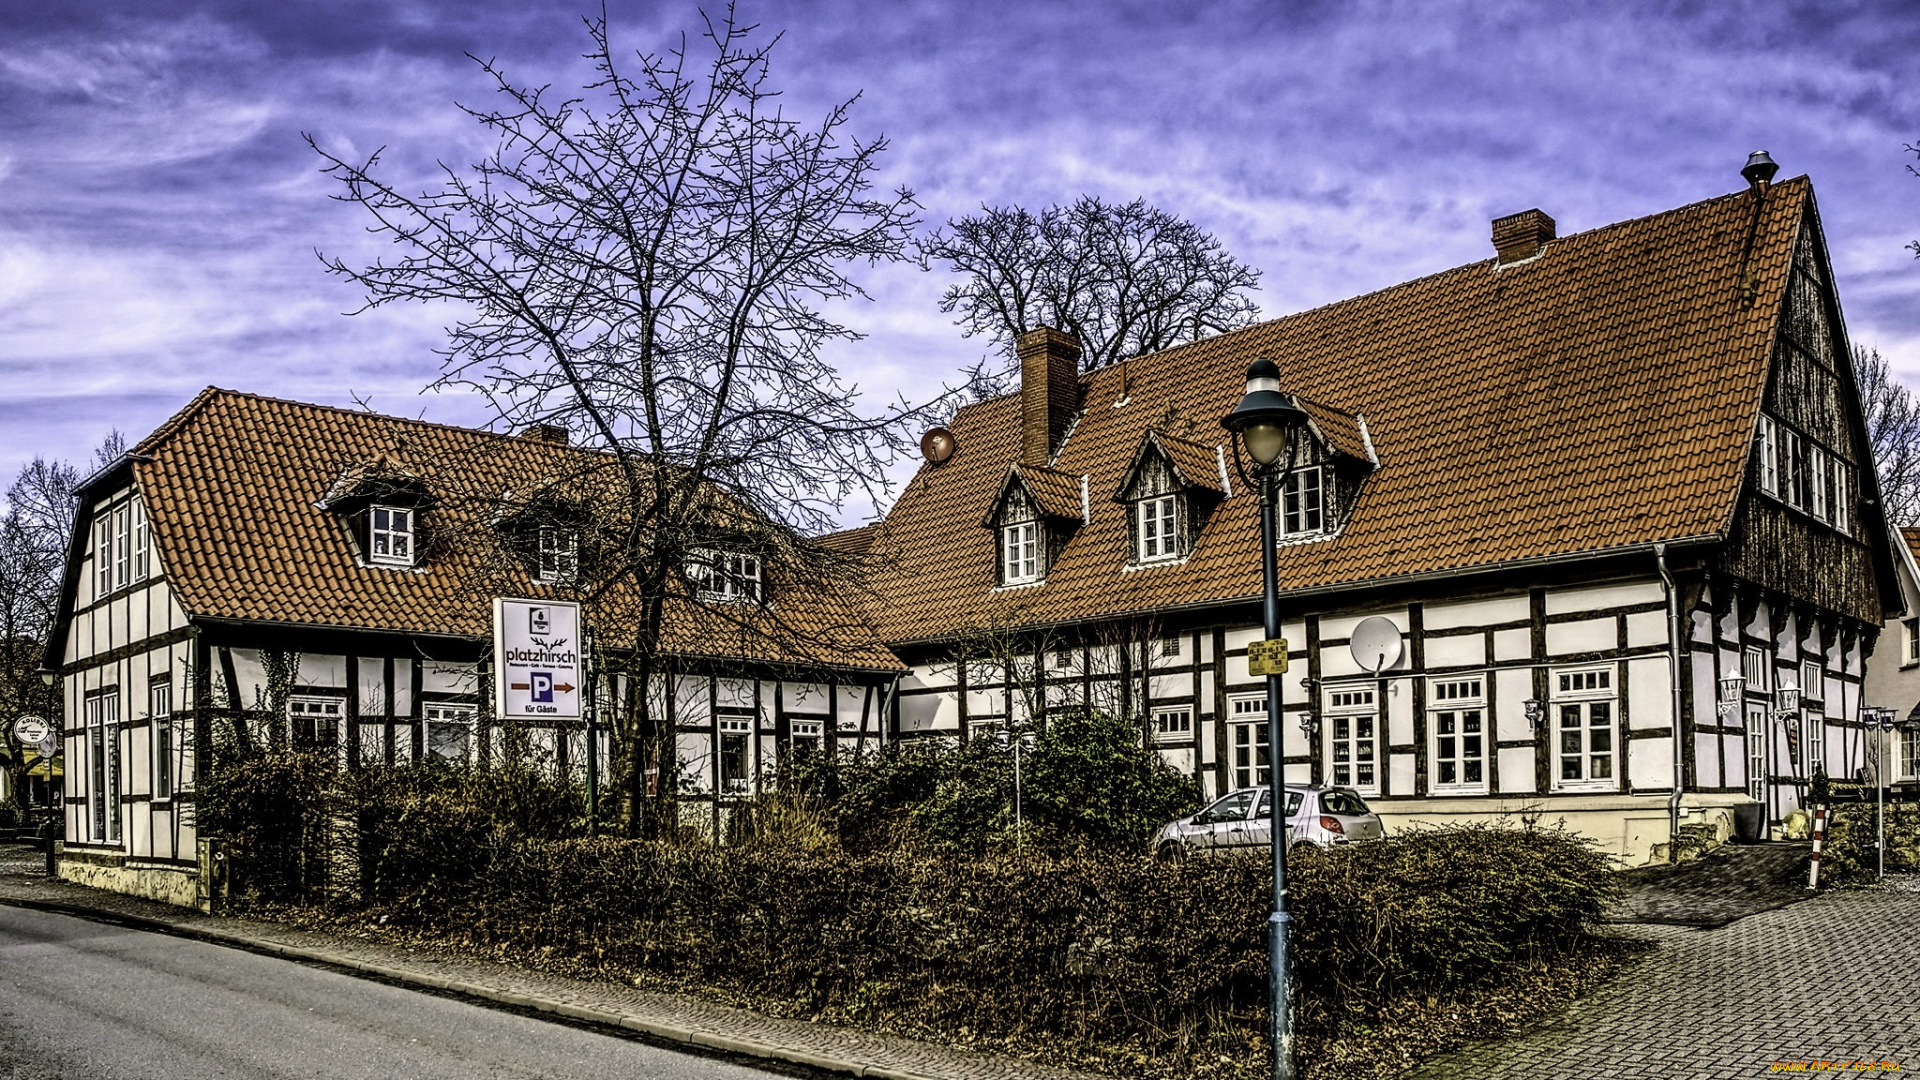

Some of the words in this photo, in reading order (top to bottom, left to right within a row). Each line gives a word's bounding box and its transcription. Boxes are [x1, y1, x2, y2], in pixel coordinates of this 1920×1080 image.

[506, 647, 576, 663] platzhirsch
[533, 676, 551, 699] P
[525, 705, 535, 713] für
[536, 705, 557, 713] Gäste
[22, 718, 46, 728] KOLIBRI
